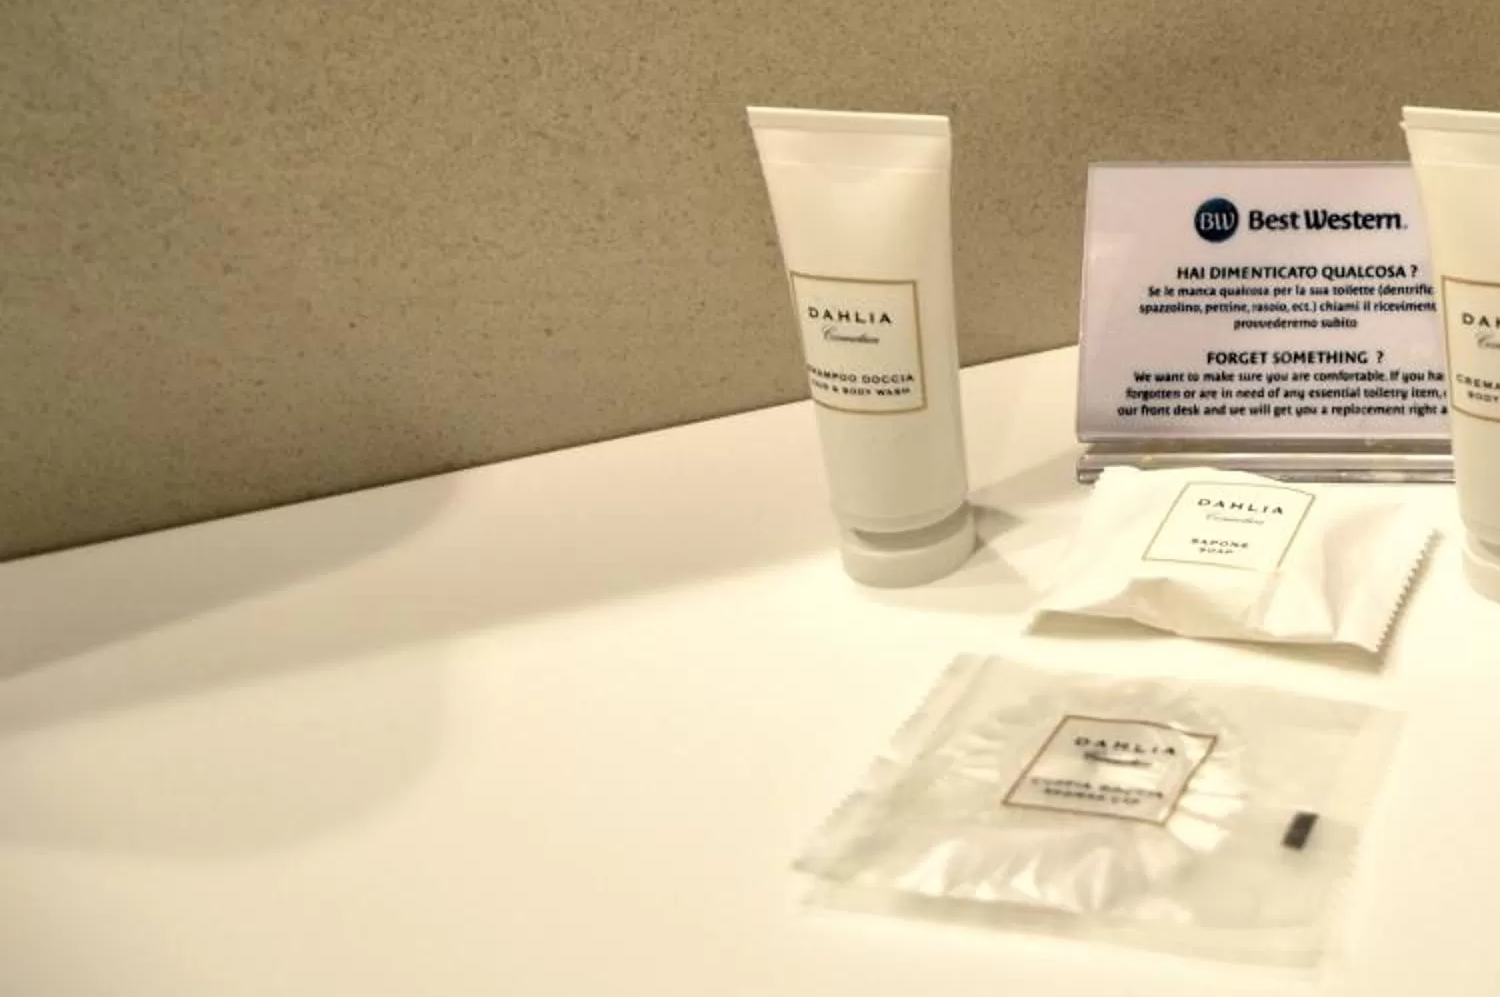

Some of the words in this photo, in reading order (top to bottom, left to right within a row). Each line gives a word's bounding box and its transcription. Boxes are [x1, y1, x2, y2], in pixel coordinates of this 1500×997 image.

[1200, 211, 1236, 231] BW
[1248, 210, 1301, 231] Best
[1177, 266, 1206, 280] HAI
[1209, 265, 1318, 280] DIMENTICATO
[1321, 264, 1407, 281] QUALCOSA
[1410, 263, 1419, 278] ?
[1147, 285, 1161, 297] Se
[1163, 284, 1175, 297] le
[1177, 286, 1217, 296] manca
[1219, 285, 1270, 299] qualcosa
[1273, 285, 1293, 298] per
[1295, 284, 1306, 296] la
[1309, 285, 1330, 296] sua
[1332, 284, 1376, 296] toilette
[1319, 301, 1360, 312] chiami
[1363, 300, 1372, 312] il
[807, 306, 893, 325] DAHLIA
[1320, 317, 1359, 329] subito
[1206, 351, 1269, 366] FORGET
[1272, 350, 1369, 365] SOMETHING
[1376, 350, 1385, 364] ?
[861, 372, 915, 385] DOCCIA
[1133, 370, 1151, 383] We
[1154, 372, 1185, 383] want
[1187, 371, 1200, 382] to
[1203, 371, 1235, 383] make
[1238, 372, 1263, 382] sure
[1265, 372, 1289, 384] you
[1291, 371, 1310, 382] are
[1313, 370, 1388, 382] comfortable.
[1390, 370, 1399, 381] If
[1401, 371, 1425, 383] you
[1125, 387, 1181, 402] forgotten
[1183, 389, 1196, 399] or
[1199, 389, 1217, 399] are
[1221, 387, 1233, 399] in
[1235, 388, 1265, 399] need
[1267, 387, 1281, 398] of
[1283, 389, 1305, 400] any
[1308, 387, 1361, 399] essential
[1363, 387, 1408, 400] toiletry
[1411, 386, 1442, 400] item,
[1116, 406, 1137, 417] our
[1140, 405, 1170, 417] front
[1173, 405, 1200, 417] desk
[1203, 405, 1227, 417] and
[1229, 406, 1246, 416] we
[1249, 405, 1271, 417] will
[1273, 405, 1292, 418] get
[1295, 406, 1317, 418] you
[1320, 407, 1328, 416] a
[1331, 405, 1405, 418] replacement
[1408, 403, 1437, 418] right
[1196, 497, 1285, 515] DAHLIA
